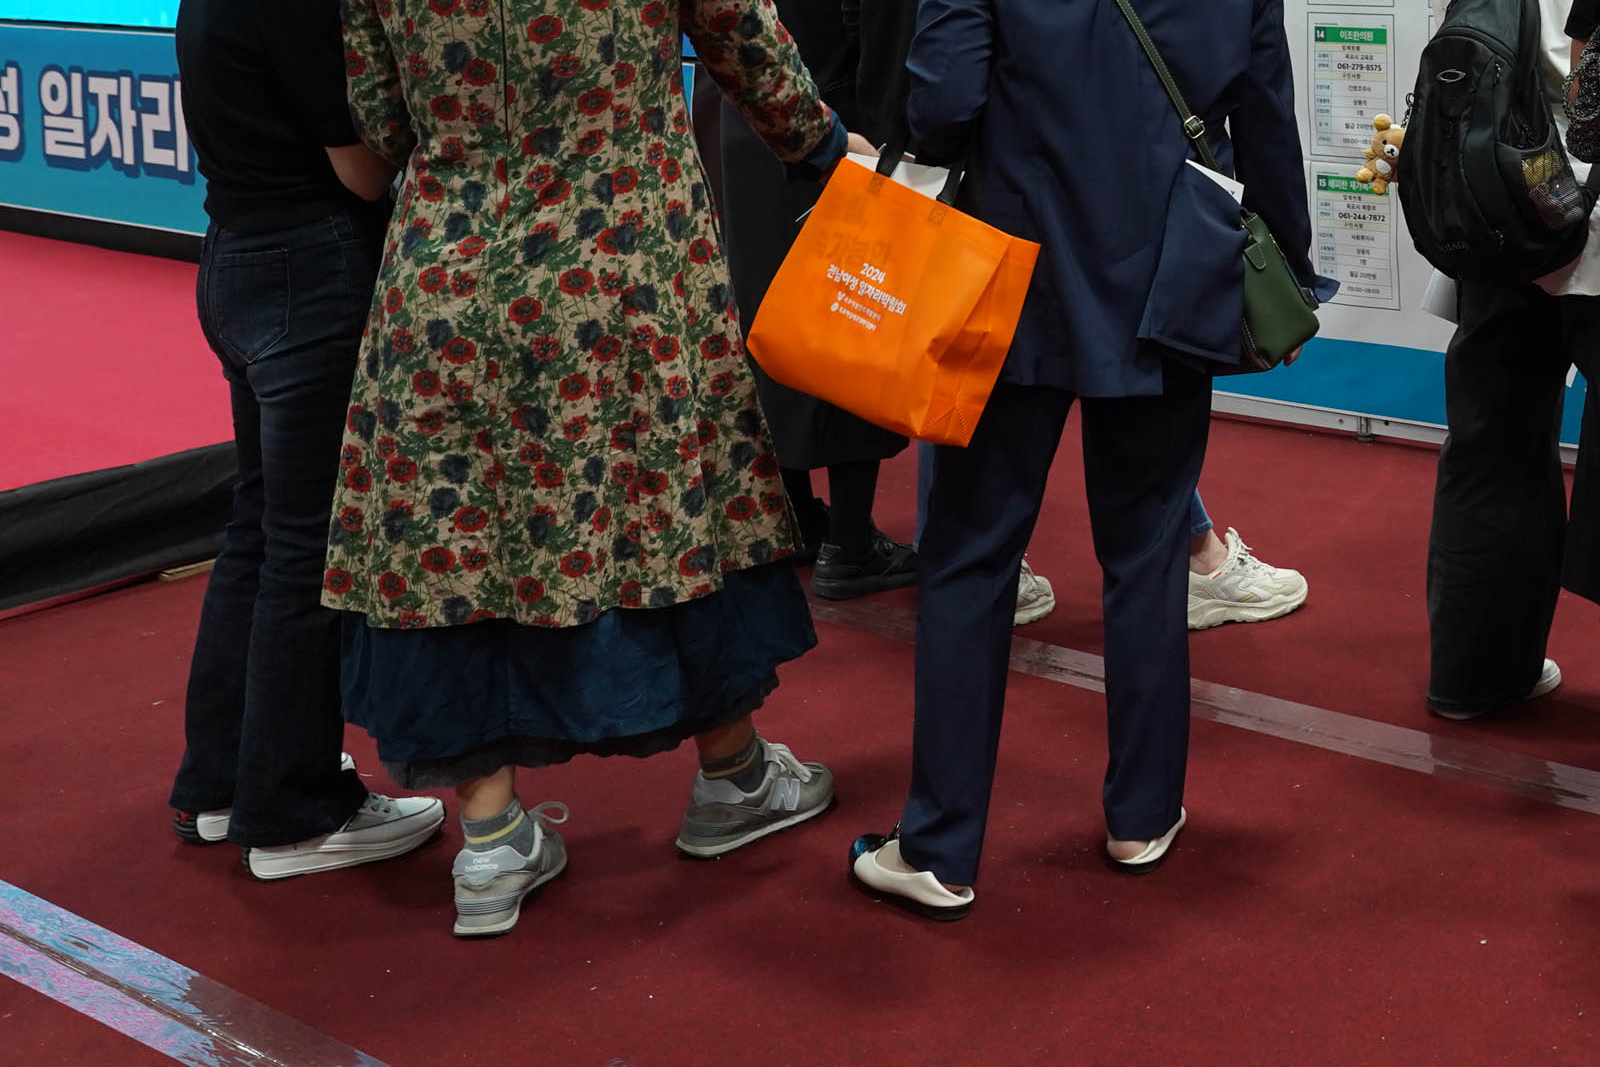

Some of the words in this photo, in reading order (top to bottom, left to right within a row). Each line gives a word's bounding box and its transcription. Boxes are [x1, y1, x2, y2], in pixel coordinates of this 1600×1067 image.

[40, 70, 189, 172] 일자리
[827, 264, 859, 291] 전남여성
[860, 263, 886, 284] 2024
[771, 777, 800, 811] N
